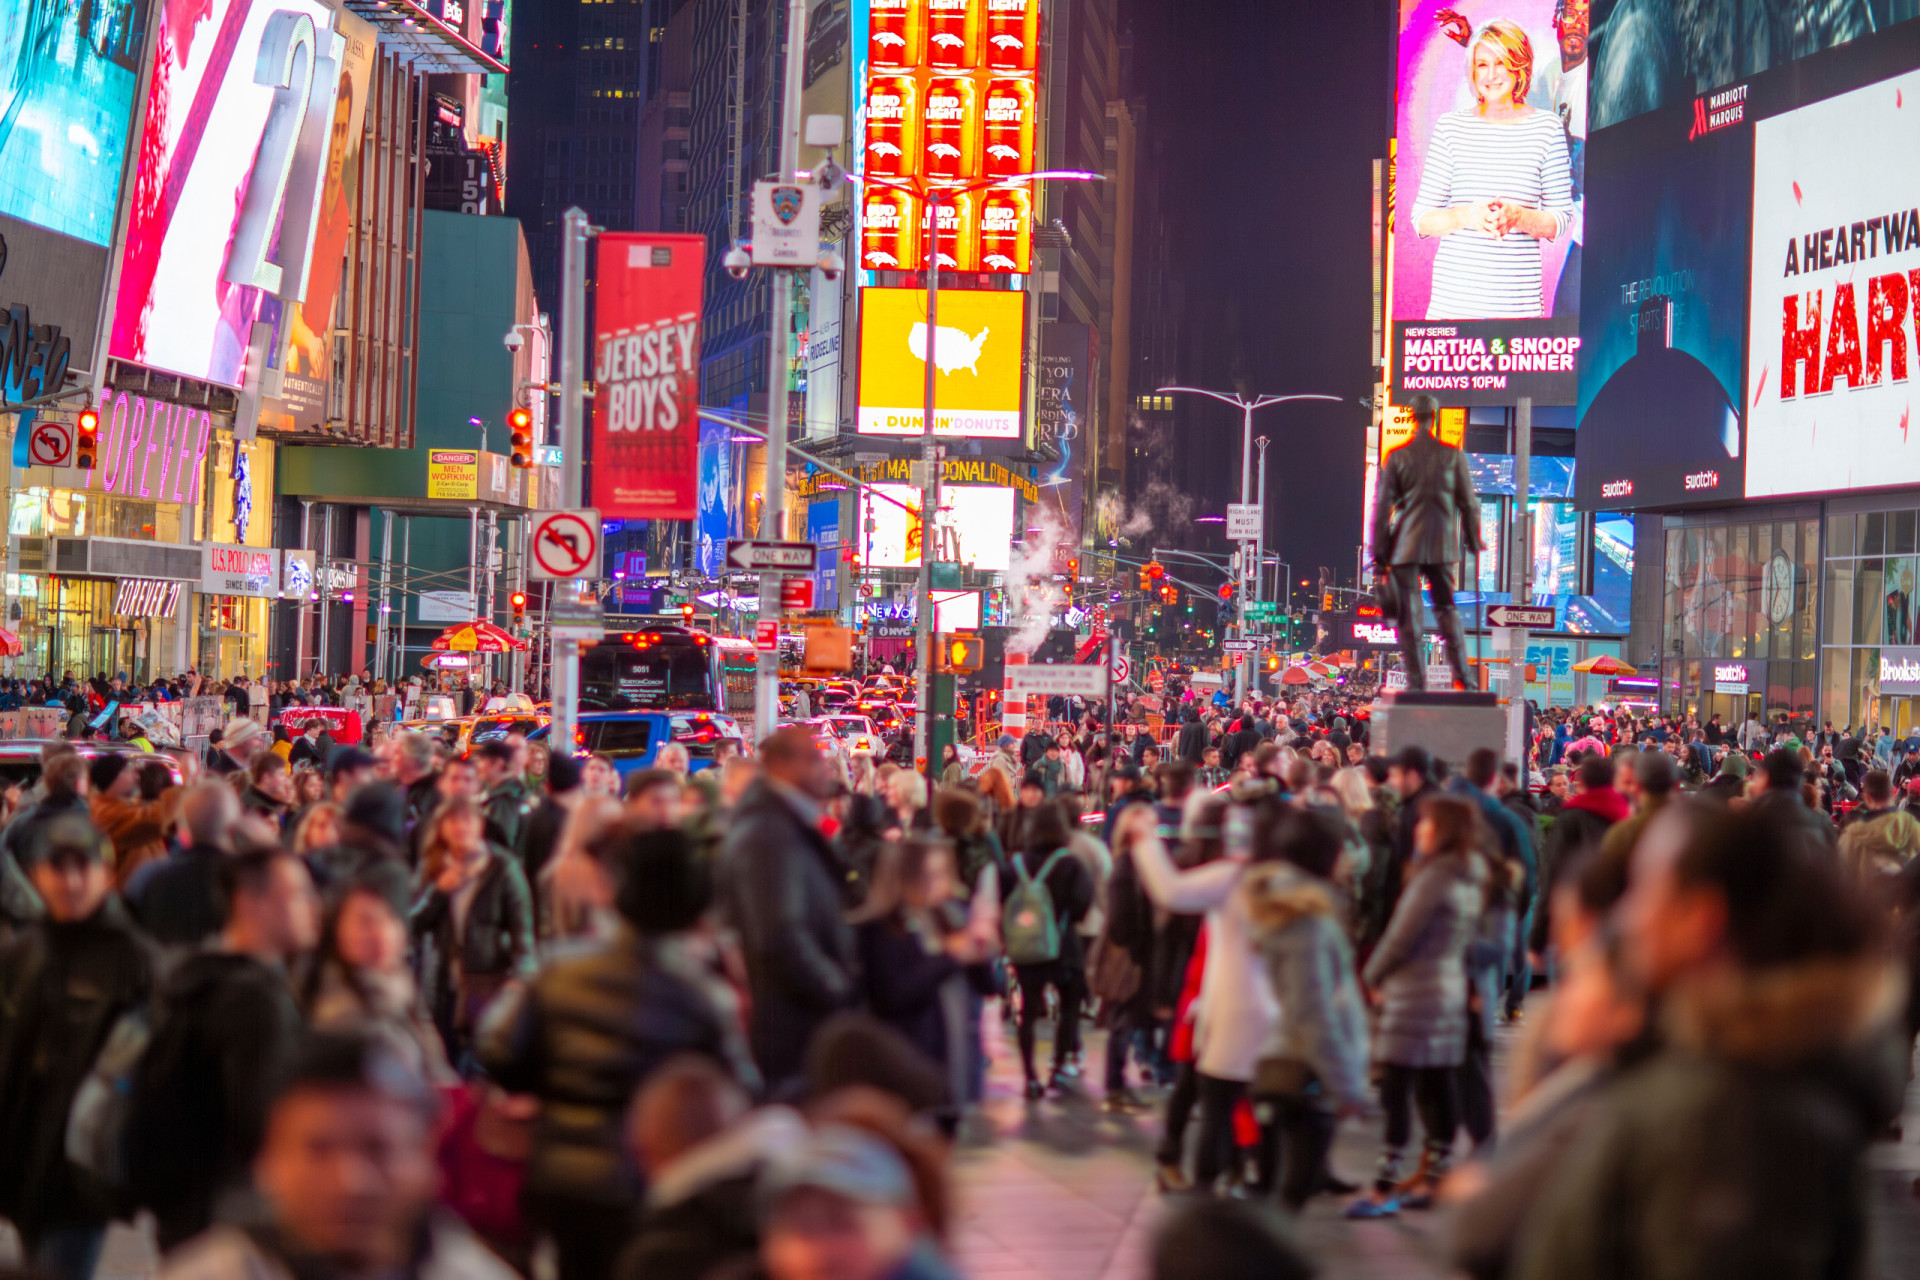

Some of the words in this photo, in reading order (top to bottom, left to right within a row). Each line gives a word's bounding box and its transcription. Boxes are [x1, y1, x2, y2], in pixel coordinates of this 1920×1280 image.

[870, 95, 900, 107] BUD
[929, 96, 959, 108] BUD
[1710, 84, 1748, 110] MARRIOTT
[988, 98, 1018, 110] BUD
[867, 107, 906, 119] LIGHT
[925, 108, 964, 120] LIGHT
[984, 110, 1023, 122] LIGHT
[1710, 105, 1743, 128] MARQUIS
[866, 204, 897, 217] BUD
[984, 207, 1014, 219] BUD
[863, 216, 902, 228] LIGHT
[981, 219, 1019, 231] LIGHT
[773, 248, 798, 257] CAMERA
[1784, 237, 1800, 278] A
[1621, 282, 1638, 304] THE
[1640, 268, 1695, 301] REVOLUTION
[1629, 308, 1661, 335] STARTS
[1427, 328, 1456, 336] SERIES
[1780, 268, 1920, 400] HAR
[596, 321, 697, 384] JERSEY
[810, 334, 840, 361] RIDGELINE
[1405, 339, 1485, 355] MARTHA
[1490, 338, 1505, 355] &
[1510, 338, 1581, 354] SNOOP
[1404, 355, 1494, 372] POTLUCK
[1499, 355, 1574, 371] DINNER
[1046, 367, 1074, 378] YOU
[1404, 376, 1469, 389] MONDAYS
[1472, 376, 1507, 389] 10PM
[608, 375, 680, 433] BOYS
[887, 416, 953, 429] DUNIN'
[954, 418, 1010, 431] DONUTS
[85, 387, 211, 506] FOREVER
[437, 454, 470, 462] DANGER
[443, 465, 463, 473] MEN
[431, 473, 475, 481] WORKING
[1235, 518, 1254, 526] MUST
[212, 548, 226, 571] U.S.
[227, 549, 249, 574] POLO
[752, 549, 777, 561] ONE
[782, 550, 808, 562] WAY
[225, 579, 244, 591] SINCE
[114, 579, 168, 617] FOREVER
[163, 582, 181, 618] 21
[867, 602, 891, 617] NEW
[1506, 612, 1525, 622] ONE
[1529, 614, 1548, 624] WAY
[889, 627, 911, 636] NYC
[1524, 646, 1569, 668] 515
[632, 665, 649, 673] 5051
[1389, 672, 1407, 685] TRU
